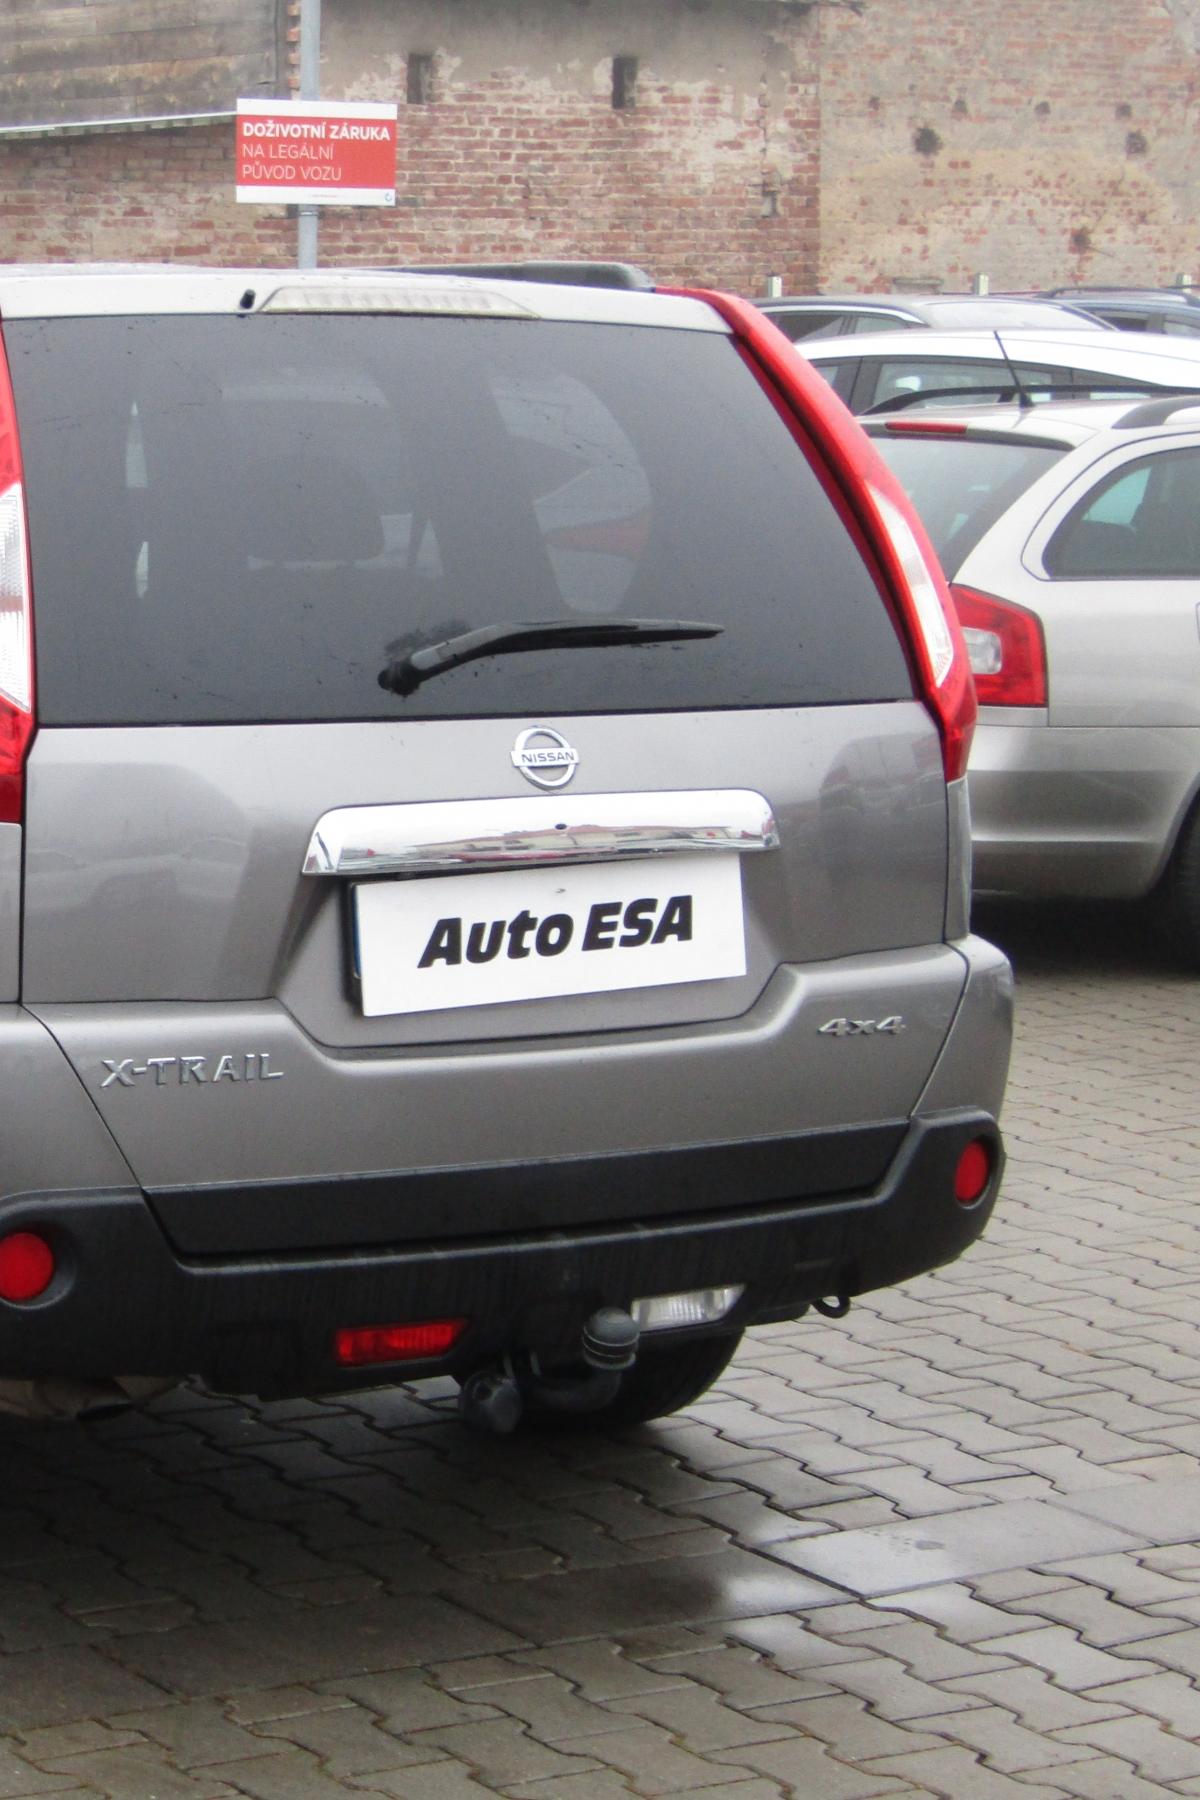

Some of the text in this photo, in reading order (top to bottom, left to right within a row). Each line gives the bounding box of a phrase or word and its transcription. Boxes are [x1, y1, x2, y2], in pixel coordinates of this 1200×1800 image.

[242, 120, 391, 141] DOŽIVOTNÍ ZÁRUKA
[242, 143, 334, 161] NA LEGÁLNÍ
[242, 161, 342, 181] PŮVOD VOZU
[521, 751, 575, 763] NISSAN
[418, 895, 692, 969] Auto ESA
[100, 1053, 284, 1087] X-TRAIL
